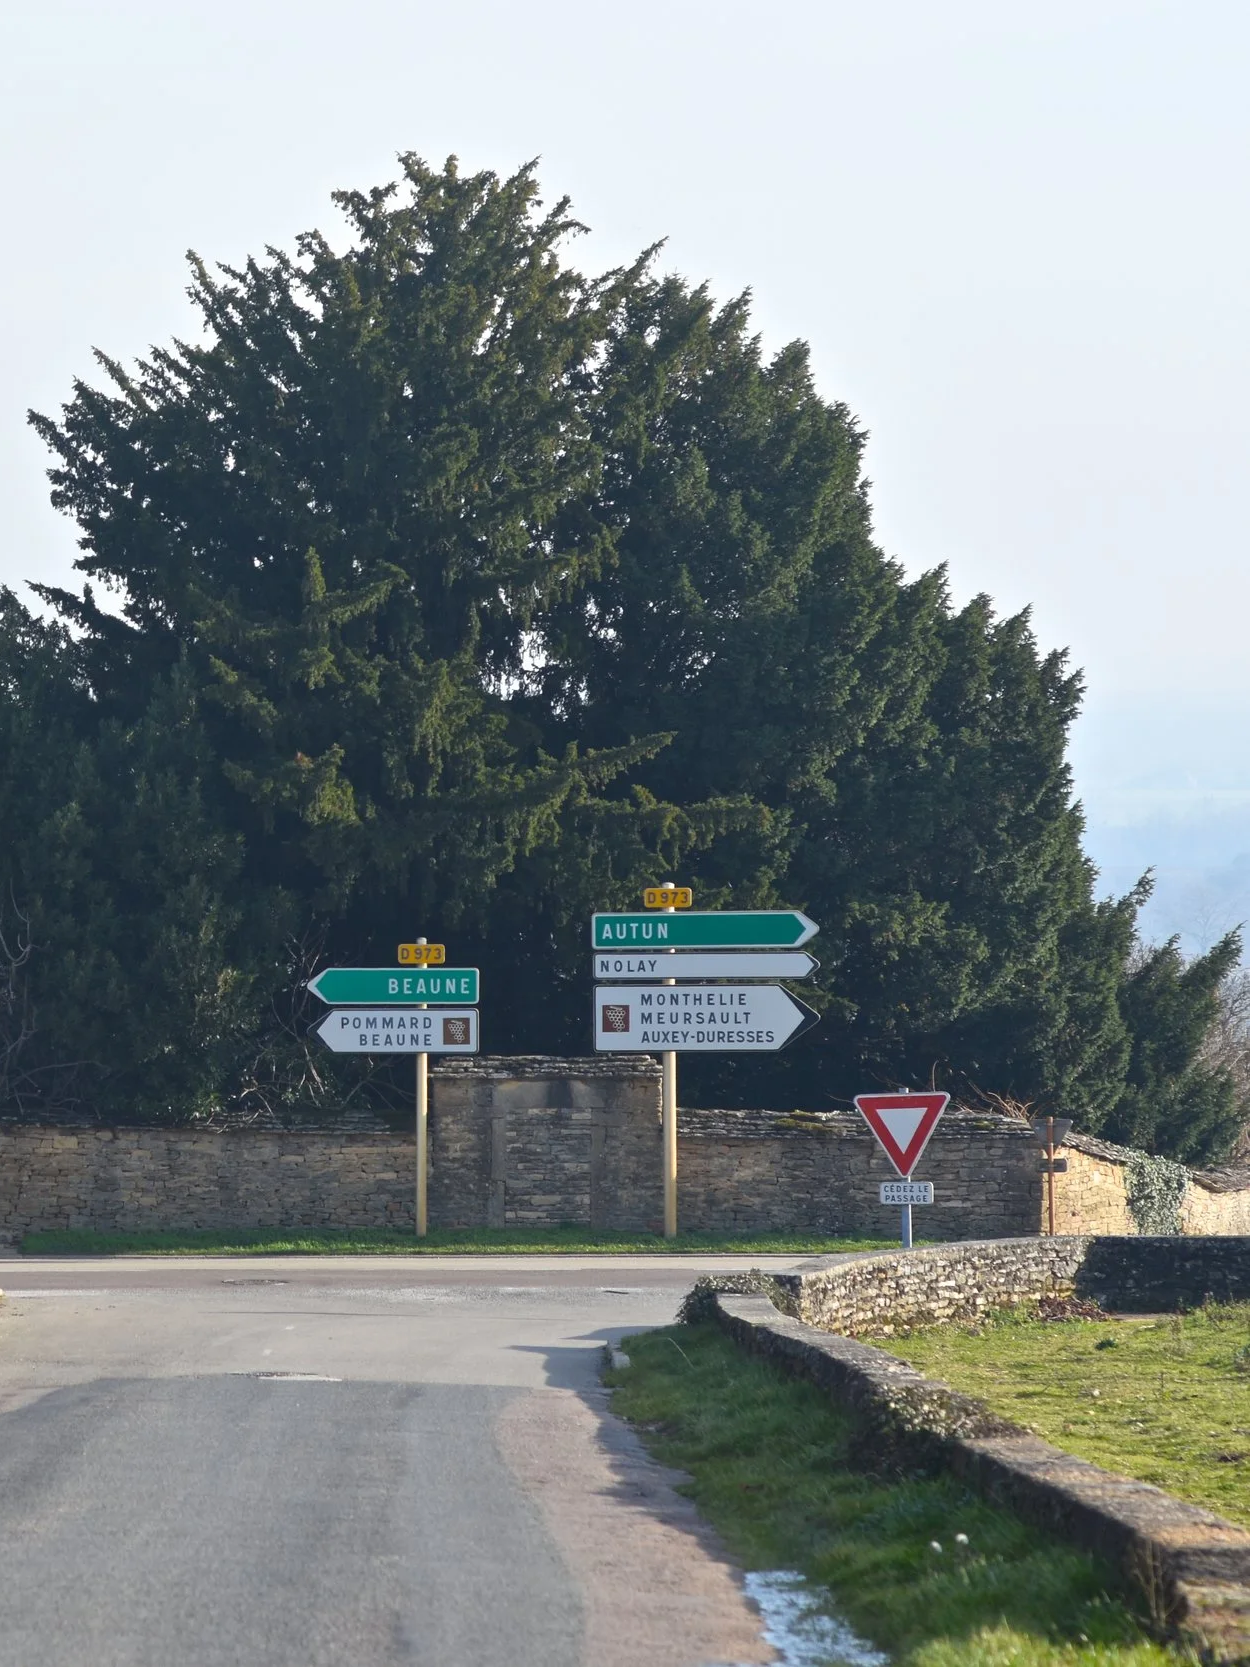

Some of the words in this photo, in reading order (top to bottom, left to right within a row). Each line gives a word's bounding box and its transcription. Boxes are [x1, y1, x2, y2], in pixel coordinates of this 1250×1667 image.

[647, 892, 656, 904] D
[660, 892, 689, 904] 973
[602, 923, 668, 939] AUTUN
[401, 948, 410, 960] D
[414, 948, 442, 960] 973
[600, 960, 657, 972] NOLAY
[388, 978, 470, 994] BEAUNE
[640, 993, 747, 1006] MONTHELIE
[341, 1017, 432, 1029] POMMARD
[640, 1012, 751, 1024] MEURSAULT
[359, 1034, 432, 1046] BEAUNE
[641, 1031, 775, 1043] AUXEY-DURESSES
[883, 1184, 915, 1193] CÉDEZ
[918, 1185, 929, 1193] LE
[885, 1195, 928, 1203] PASSAGE
